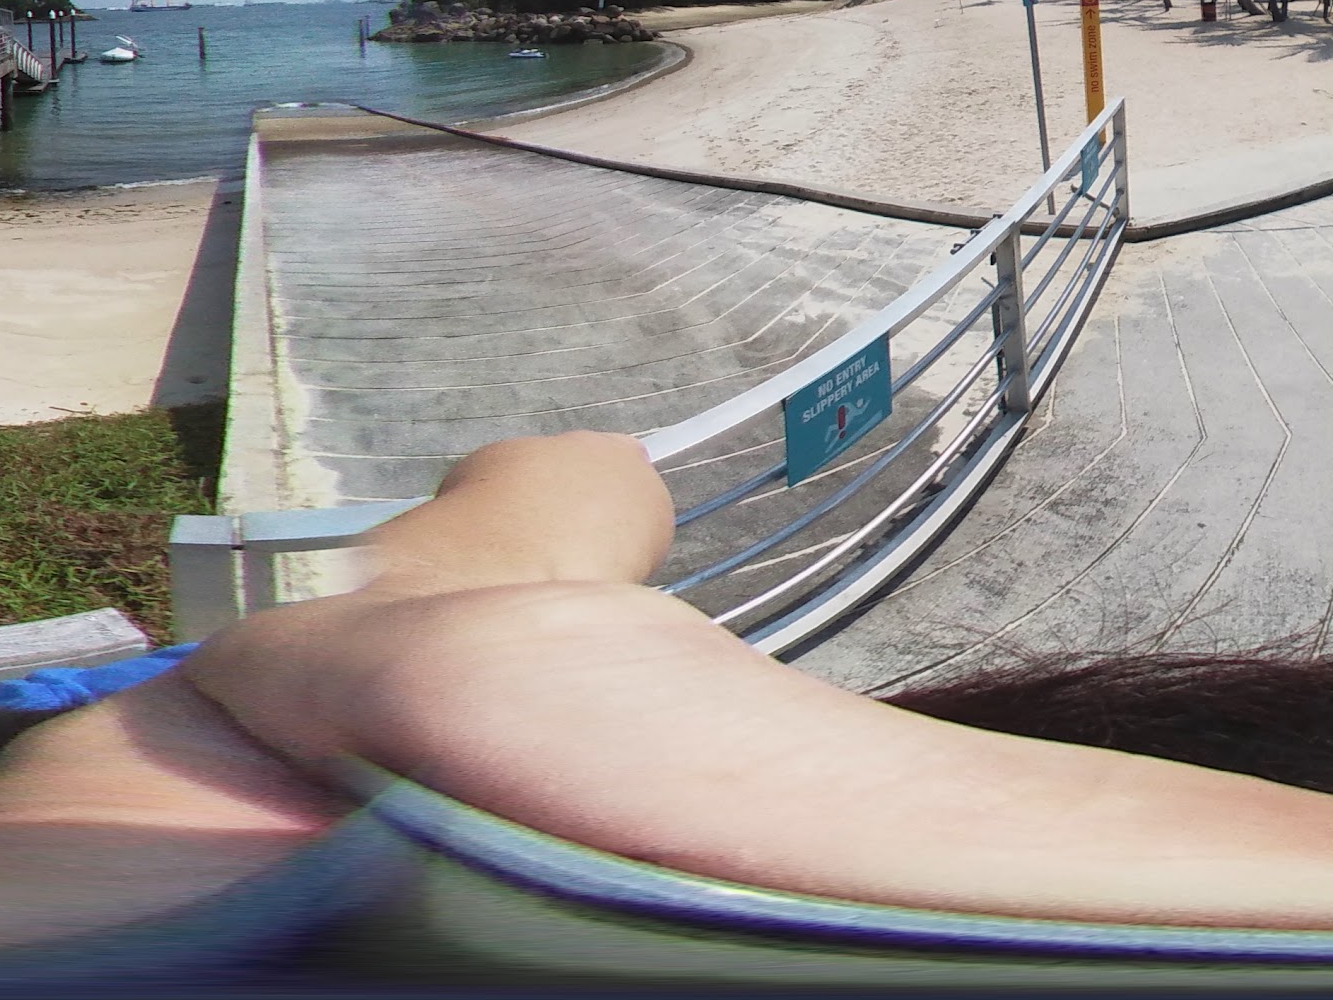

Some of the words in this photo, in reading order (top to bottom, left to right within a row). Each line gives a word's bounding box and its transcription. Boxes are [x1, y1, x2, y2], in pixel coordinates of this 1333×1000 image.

[1087, 25, 1097, 49] zone
[1088, 51, 1099, 78] swim
[1091, 80, 1099, 93] no
[817, 379, 834, 398] NO
[835, 355, 867, 386] ENTRY
[802, 380, 854, 423] SLIPPERY
[855, 361, 881, 387] AREA
